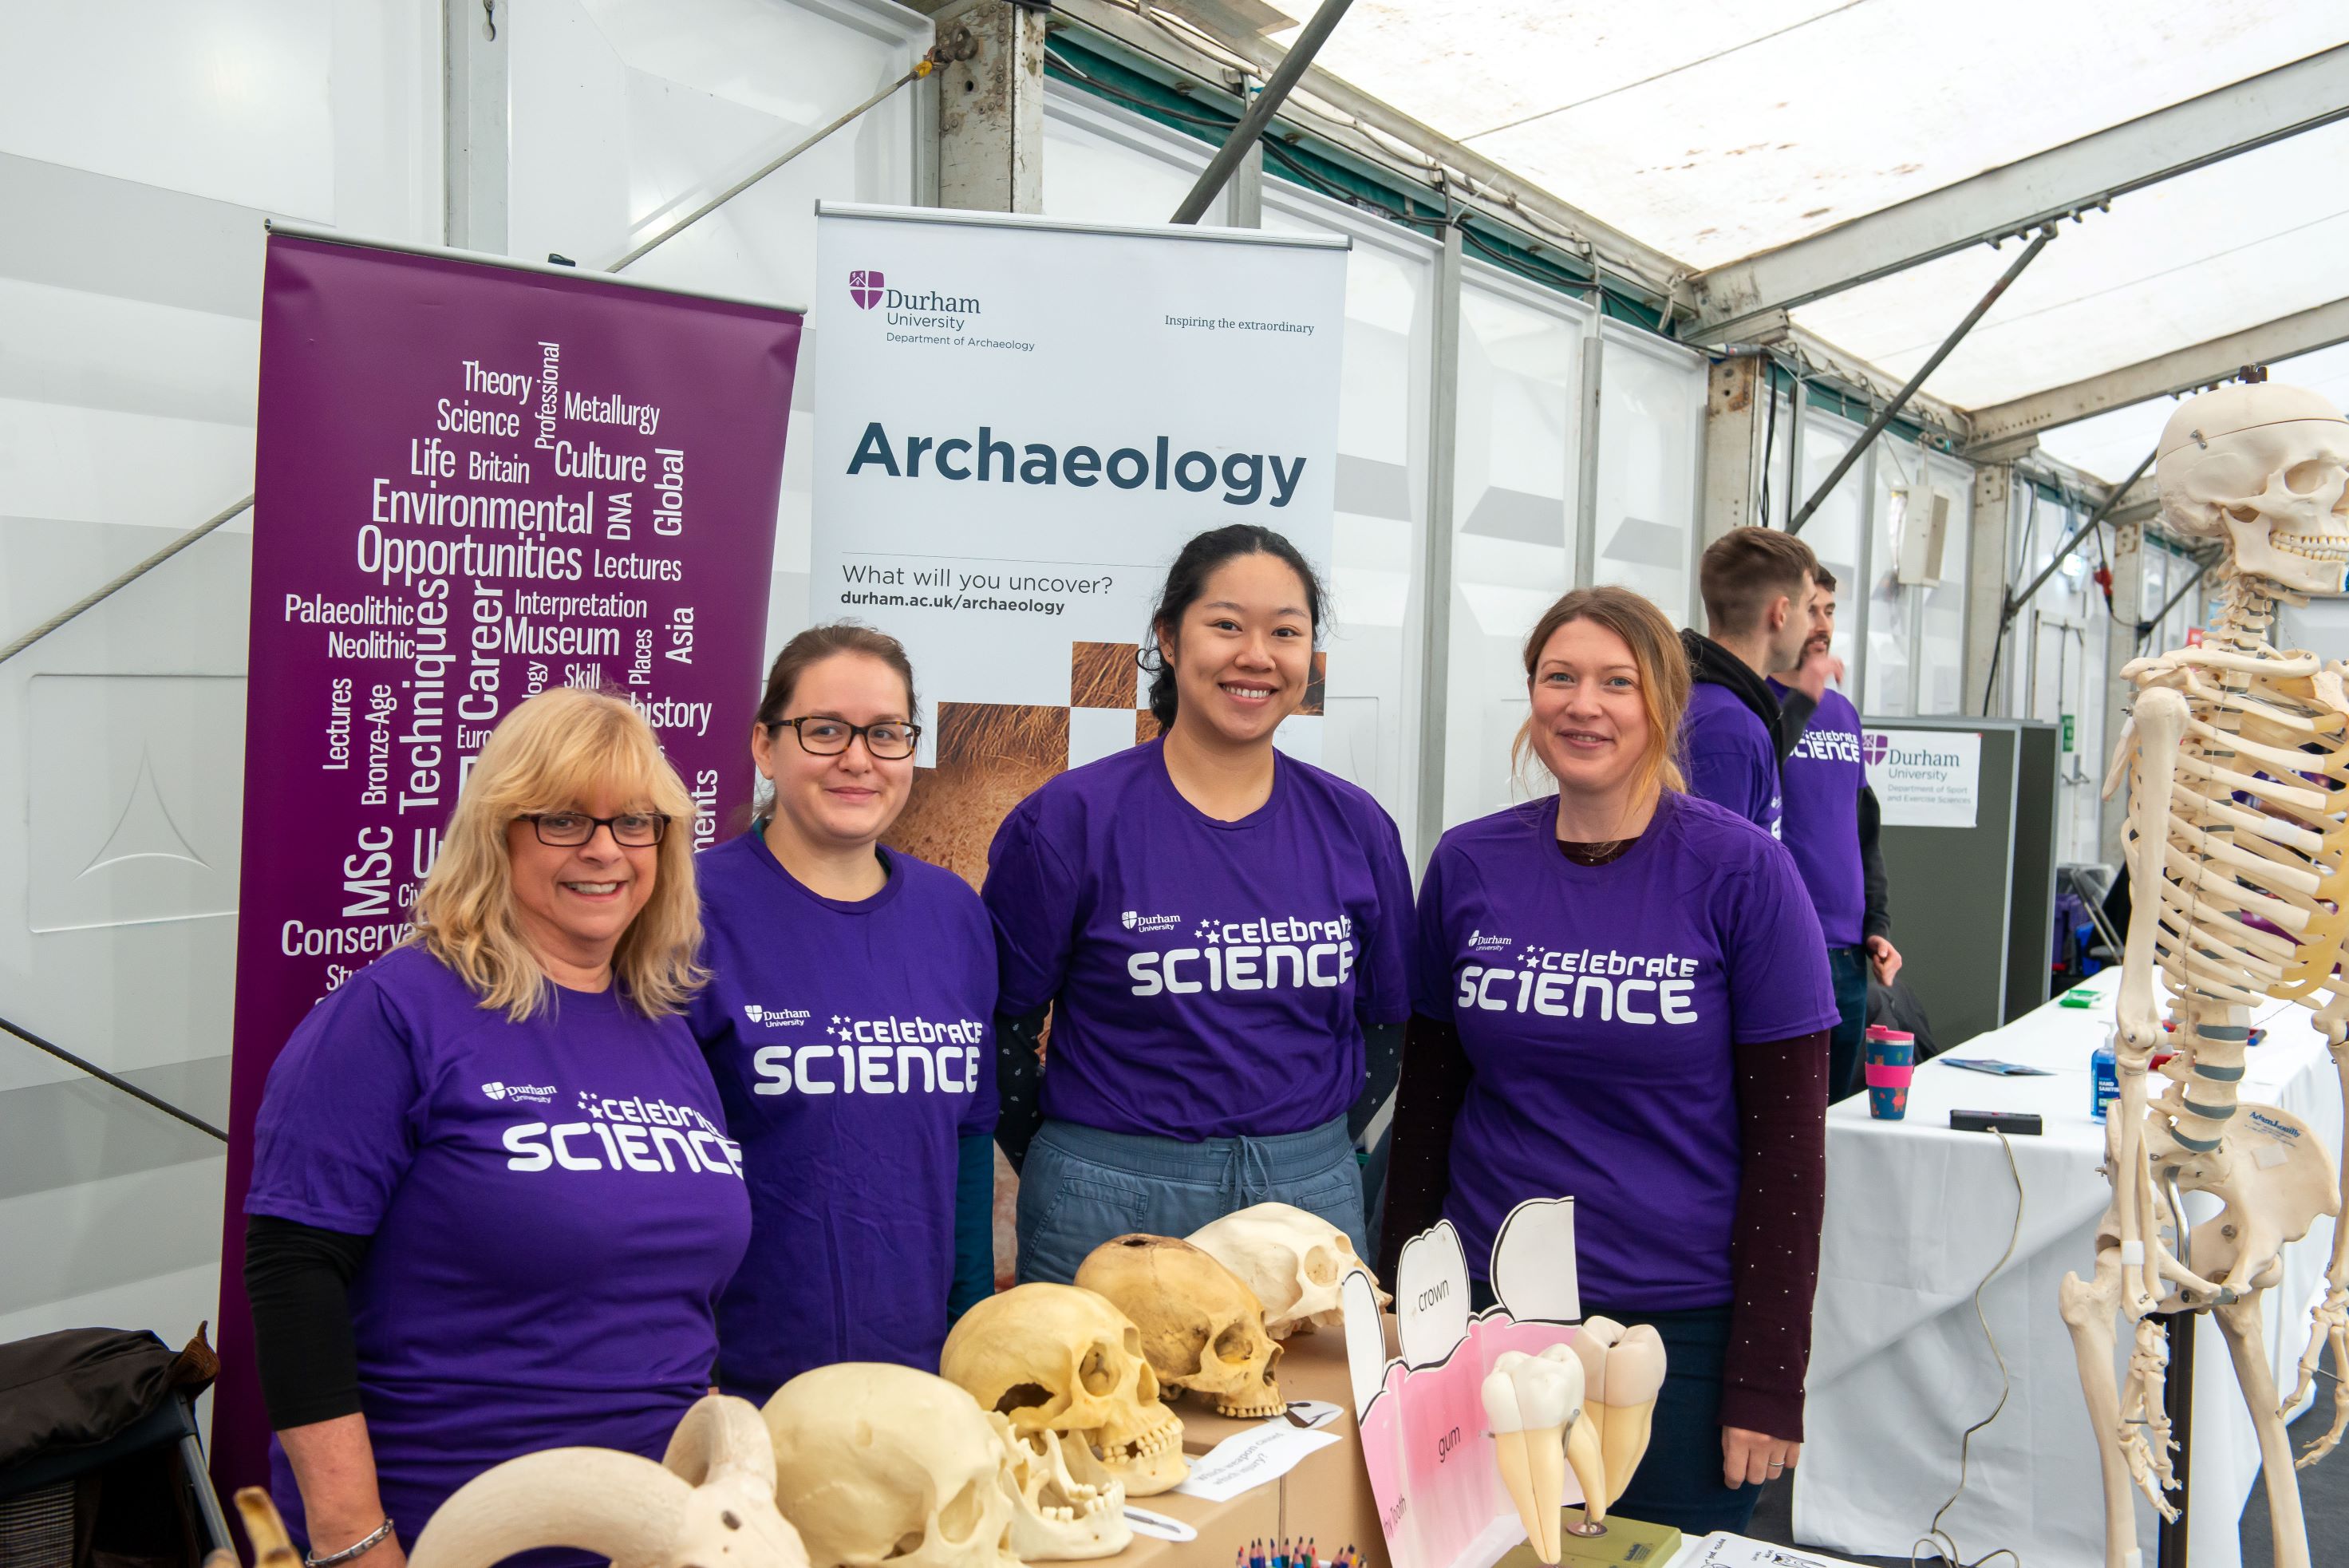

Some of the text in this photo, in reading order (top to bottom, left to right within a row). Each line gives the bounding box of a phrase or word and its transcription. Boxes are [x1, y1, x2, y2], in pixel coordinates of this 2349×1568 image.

[886, 290, 980, 314] Durham
[888, 313, 964, 331] University
[1166, 315, 1314, 335] Inspiring the extraordinary
[887, 333, 950, 344] Department
[968, 338, 1034, 351] Archaeology
[463, 361, 532, 405] Theory
[535, 342, 559, 449] Professional
[437, 399, 519, 436] Science
[565, 391, 660, 435] Metallurgy
[412, 438, 455, 477] Life
[469, 452, 529, 484] Britain
[555, 440, 645, 482] Culture
[847, 422, 1306, 507] Archaeology
[373, 478, 593, 534] Environmental
[653, 448, 683, 535] Global
[607, 492, 632, 540] DNA
[358, 525, 582, 586] Opportunities
[594, 549, 681, 581] Lectures
[843, 565, 1112, 594] What will you uncover?
[286, 594, 413, 626] Palaeolithic
[515, 589, 646, 622] Interpretation
[841, 591, 1064, 615] durham.ac.uk/archaeology
[329, 630, 415, 658] Neolithic
[459, 580, 503, 720] Career
[504, 616, 619, 655] Museum
[665, 607, 693, 664] Asia
[628, 630, 652, 684] Places
[398, 579, 456, 814] Techniques
[522, 661, 548, 698] logy
[323, 678, 352, 769] Lectures
[631, 692, 712, 737] history
[361, 685, 397, 804] Bronze-Age
[458, 725, 492, 748] Euro
[1790, 739, 1860, 763] CIENCE
[1889, 749, 1959, 767] Durham
[1889, 768, 1947, 782] University
[1888, 784, 1933, 793] Department
[342, 827, 393, 916] MSc
[282, 919, 416, 956] Conserva
[1138, 914, 1181, 926] Durham
[1478, 936, 1511, 945] Durham
[764, 1009, 811, 1021] Durham
[506, 1084, 558, 1096] Durham
[1419, 1280, 1449, 1312] crown
[1226, 1445, 1255, 1468] weapon
[1439, 1427, 1460, 1463] gum
